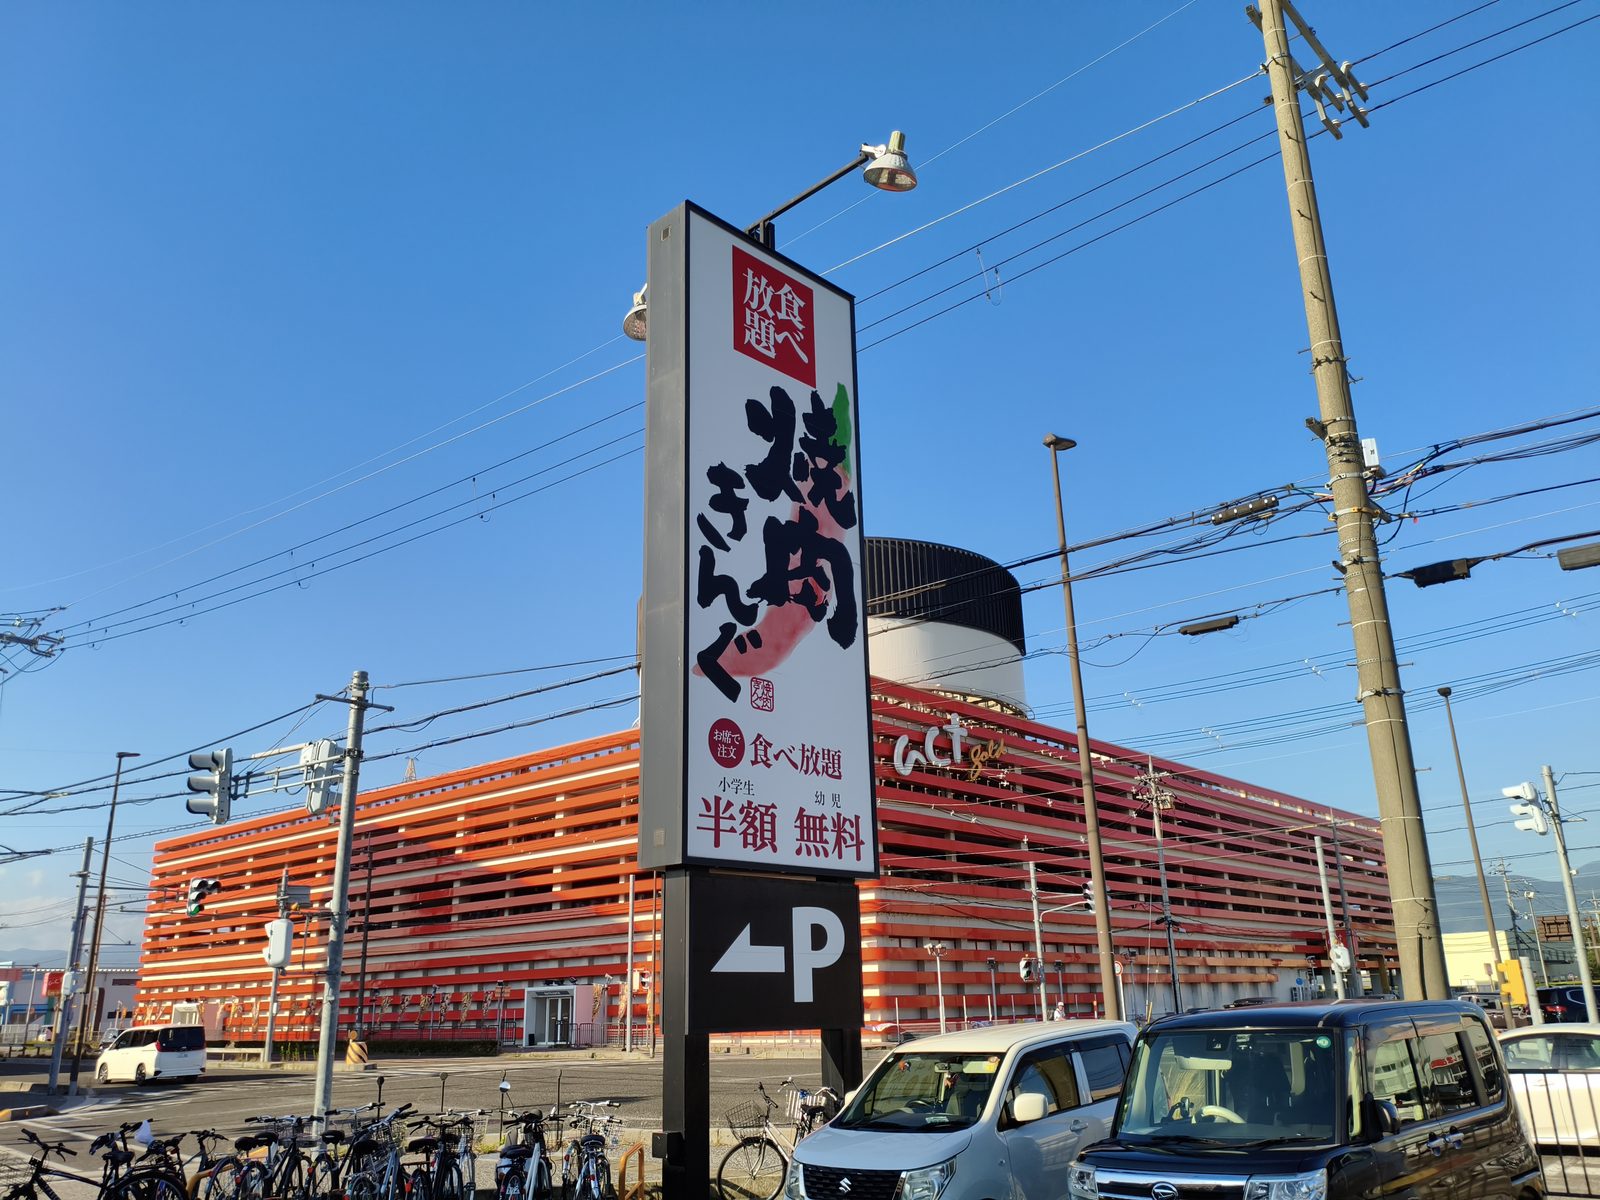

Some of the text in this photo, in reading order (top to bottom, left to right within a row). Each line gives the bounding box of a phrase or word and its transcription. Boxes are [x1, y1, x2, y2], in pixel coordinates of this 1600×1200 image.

[743, 267, 776, 359] 放題
[775, 283, 809, 364] 食べ
[744, 385, 859, 650] 焼肉
[696, 460, 760, 703] きんぐ
[713, 729, 741, 745] お席で
[717, 743, 737, 759] 注文
[750, 733, 842, 780] 食べ放題
[718, 776, 755, 796] 小学生
[814, 790, 842, 809] 幼児
[697, 795, 778, 853] 半額
[794, 806, 865, 862] 無料
[792, 906, 846, 1003] P
